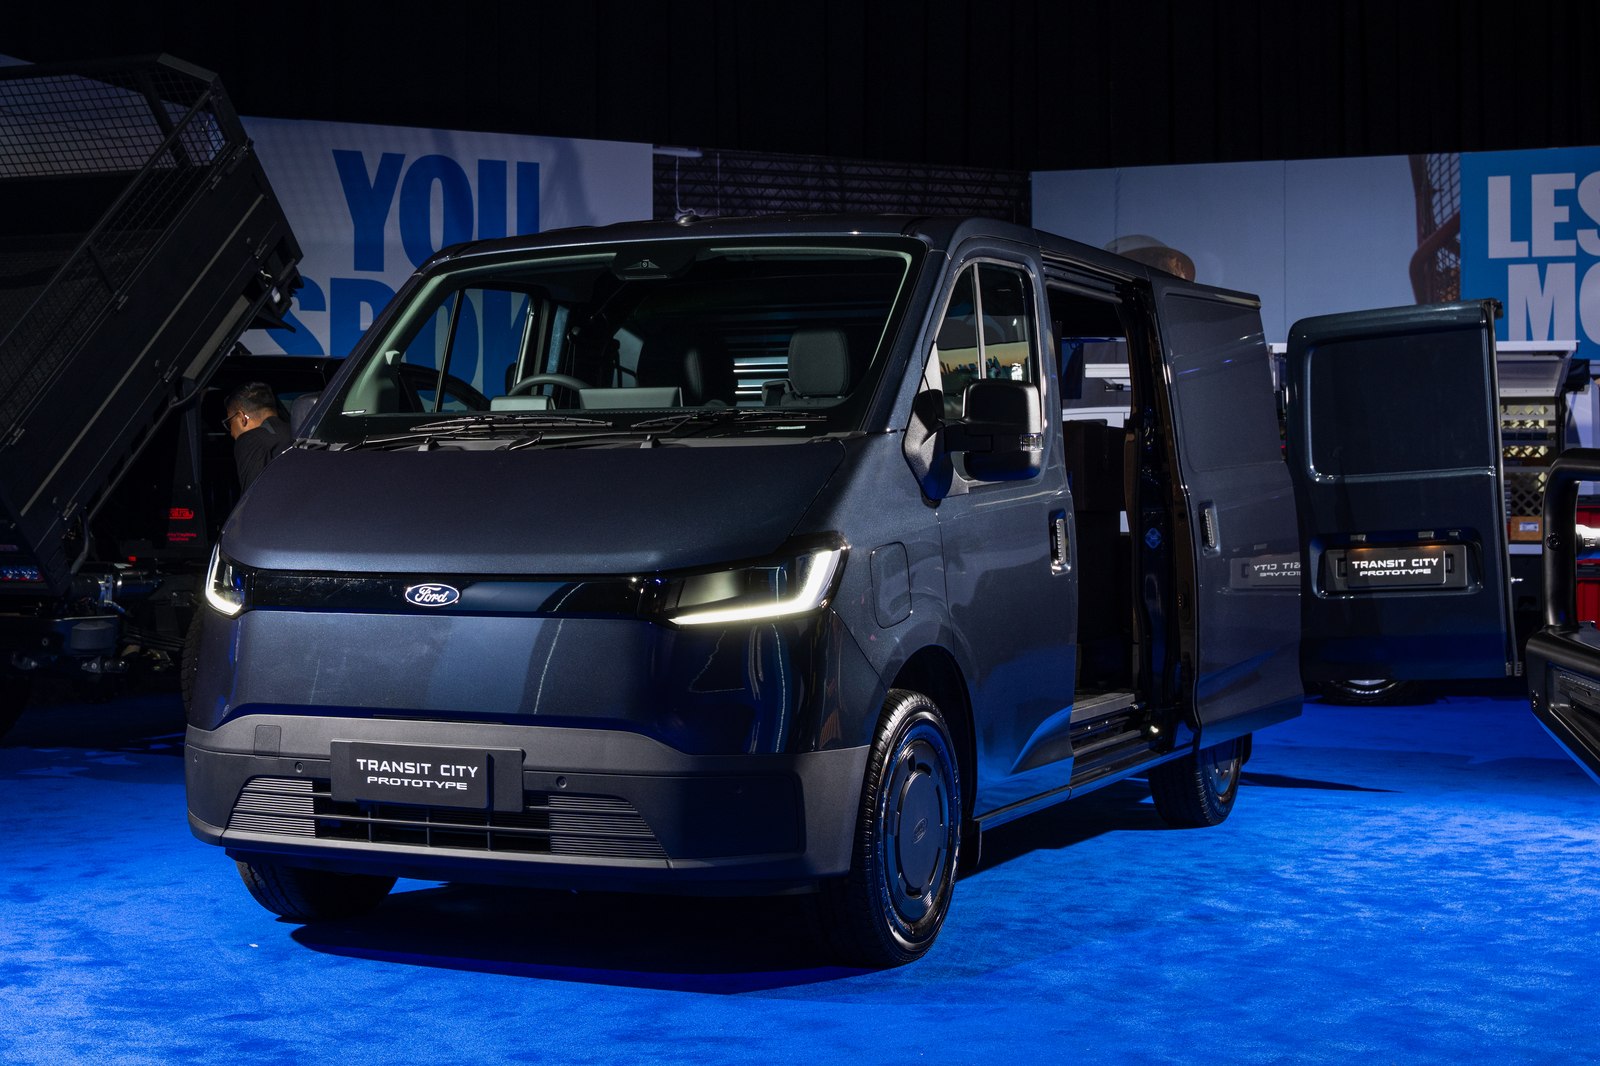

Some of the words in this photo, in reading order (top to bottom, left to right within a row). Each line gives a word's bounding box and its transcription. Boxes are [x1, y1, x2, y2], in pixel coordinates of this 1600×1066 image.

[332, 149, 539, 272] YOU
[1352, 559, 1406, 569] TRANSIT
[1411, 557, 1439, 567] CITY
[1359, 568, 1431, 577] PROTOTYPE
[356, 758, 432, 775] TRANSIT
[440, 764, 478, 778] CITY
[366, 776, 468, 791] PROTOTYPE
